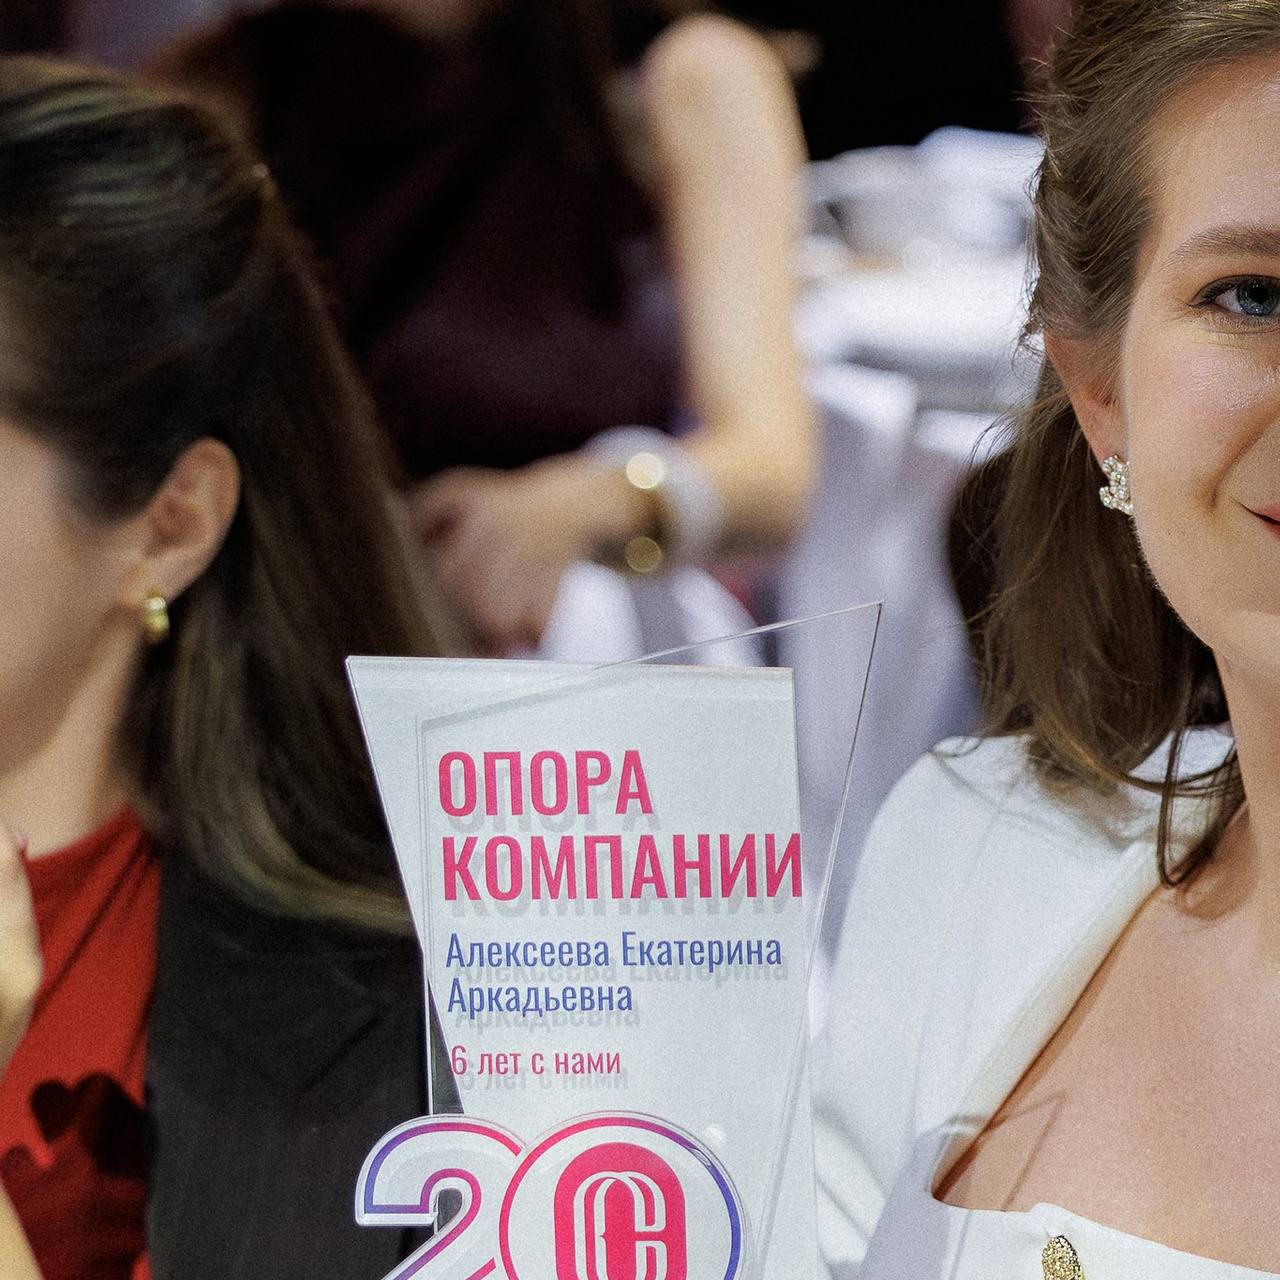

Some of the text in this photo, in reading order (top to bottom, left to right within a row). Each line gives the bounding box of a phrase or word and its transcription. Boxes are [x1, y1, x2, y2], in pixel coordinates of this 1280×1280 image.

[437, 749, 654, 818] ОПОРА
[442, 832, 803, 902] КОМПАНИИ
[445, 931, 783, 973] Алексеева Екатерина
[447, 977, 633, 1020] Аркадьевна
[450, 1044, 622, 1076] 6 лет с нами
